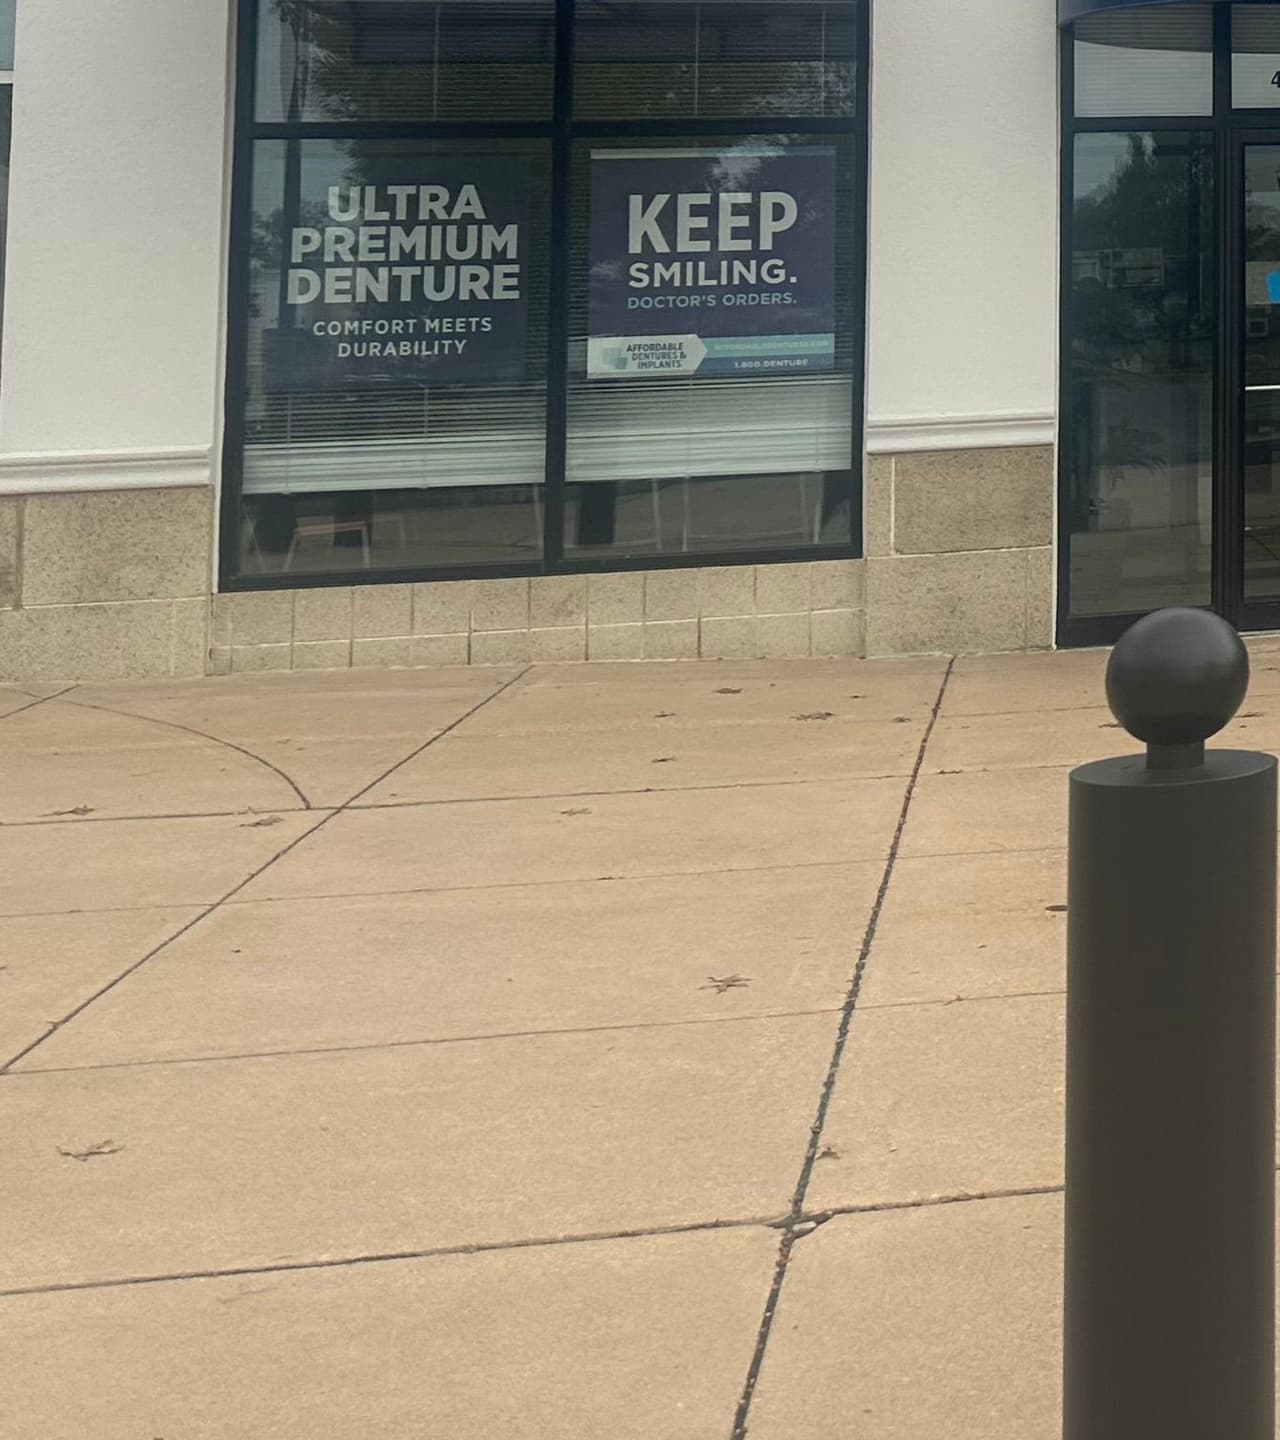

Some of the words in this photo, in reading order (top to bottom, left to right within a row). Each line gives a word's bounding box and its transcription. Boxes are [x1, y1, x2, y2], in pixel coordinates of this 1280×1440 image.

[327, 184, 487, 222] ULTRA
[628, 191, 799, 254] KEEP
[291, 224, 519, 263] PREMIUM
[628, 259, 798, 288] SMILING.
[287, 264, 521, 305] DENTURE
[627, 295, 717, 310] DOCTOR'S
[722, 292, 797, 306] ORDERS.
[312, 318, 418, 337] COMFORT
[424, 316, 493, 333] MEETS
[337, 339, 468, 358] DURABILITY
[626, 342, 684, 353] AFFORDABLE
[632, 352, 678, 361] DENTURES
[679, 351, 688, 359] &
[637, 360, 682, 370] IMPLANTS
